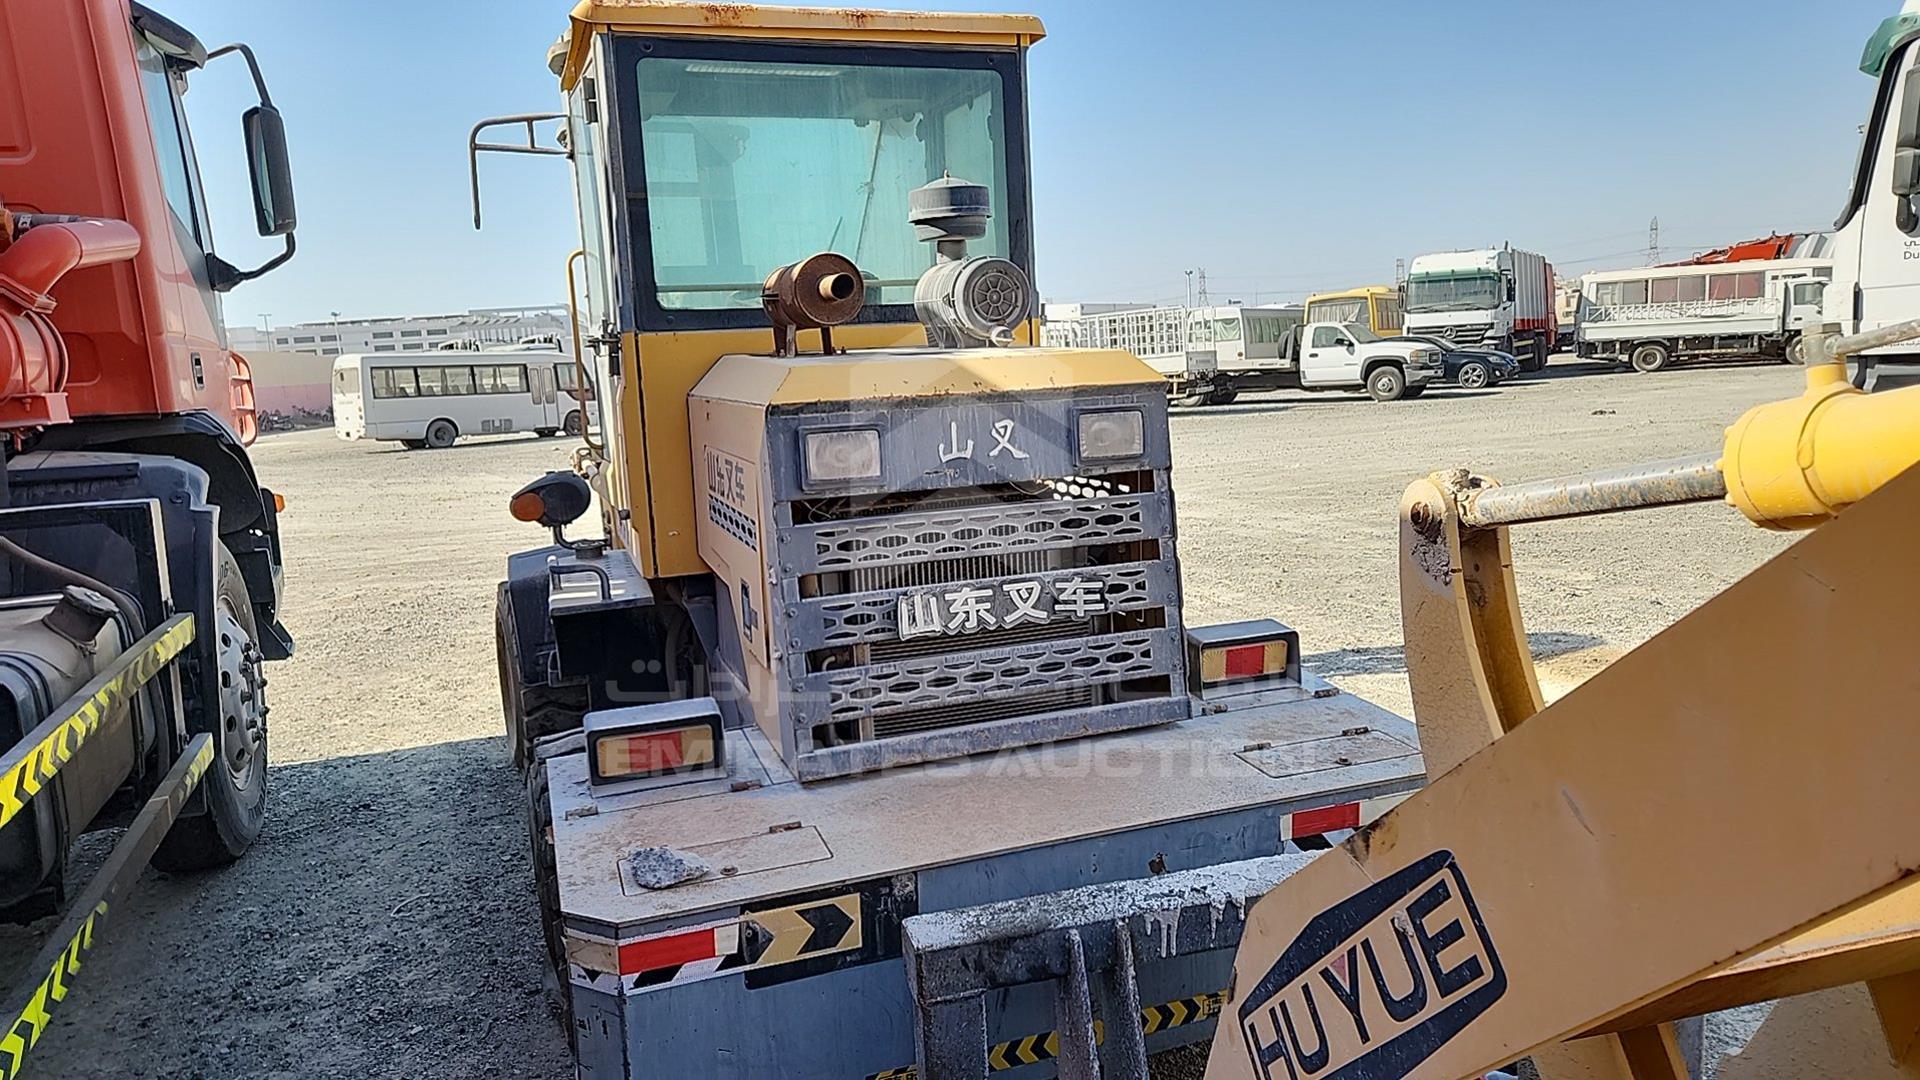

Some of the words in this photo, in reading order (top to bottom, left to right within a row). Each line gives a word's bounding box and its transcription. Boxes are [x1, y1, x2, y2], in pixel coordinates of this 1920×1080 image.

[899, 576, 1106, 640] 山东叉车
[1248, 878, 1485, 1080] HUYUE
